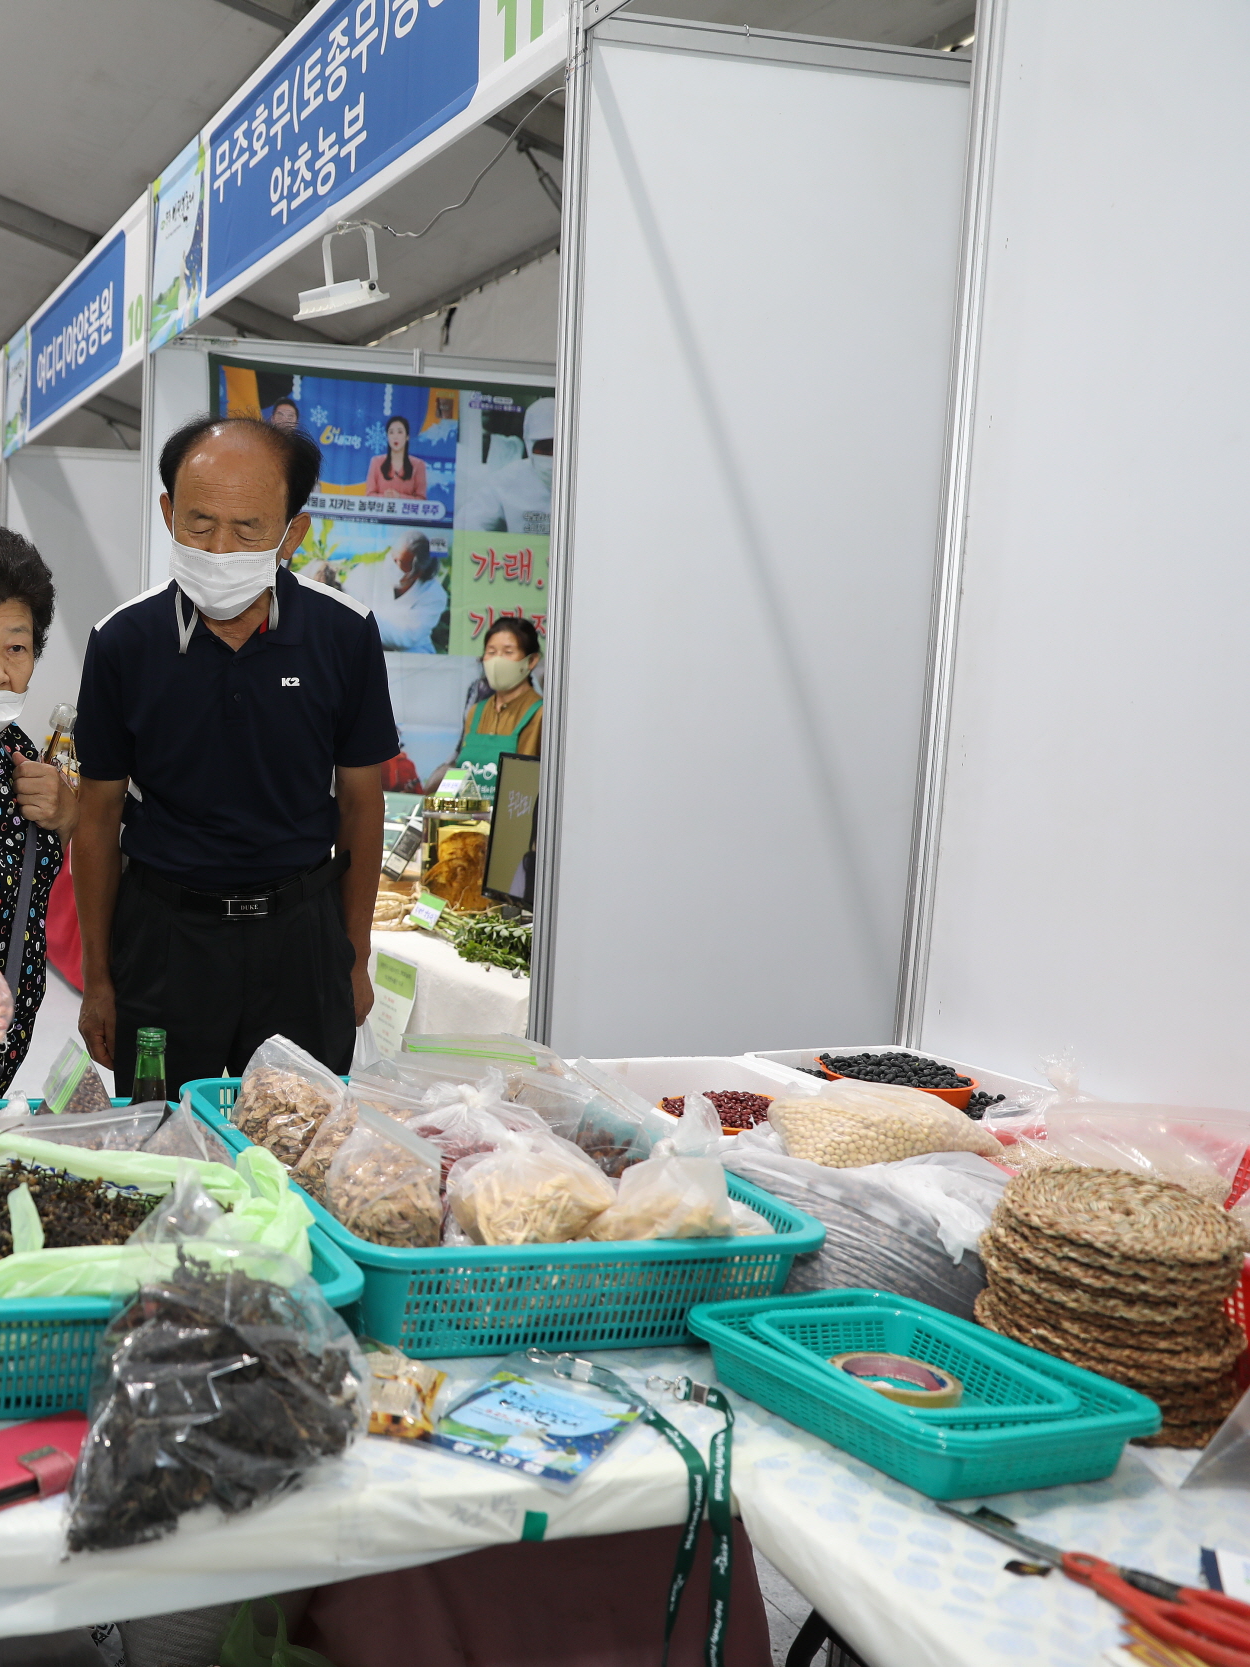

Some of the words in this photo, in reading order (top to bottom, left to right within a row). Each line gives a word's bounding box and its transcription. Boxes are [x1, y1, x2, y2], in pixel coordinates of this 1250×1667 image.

[496, 0, 544, 63] 11
[270, 92, 367, 225] 약초농부
[127, 293, 143, 347] 10
[281, 677, 300, 687] K2
[240, 903, 259, 911] DUKE
